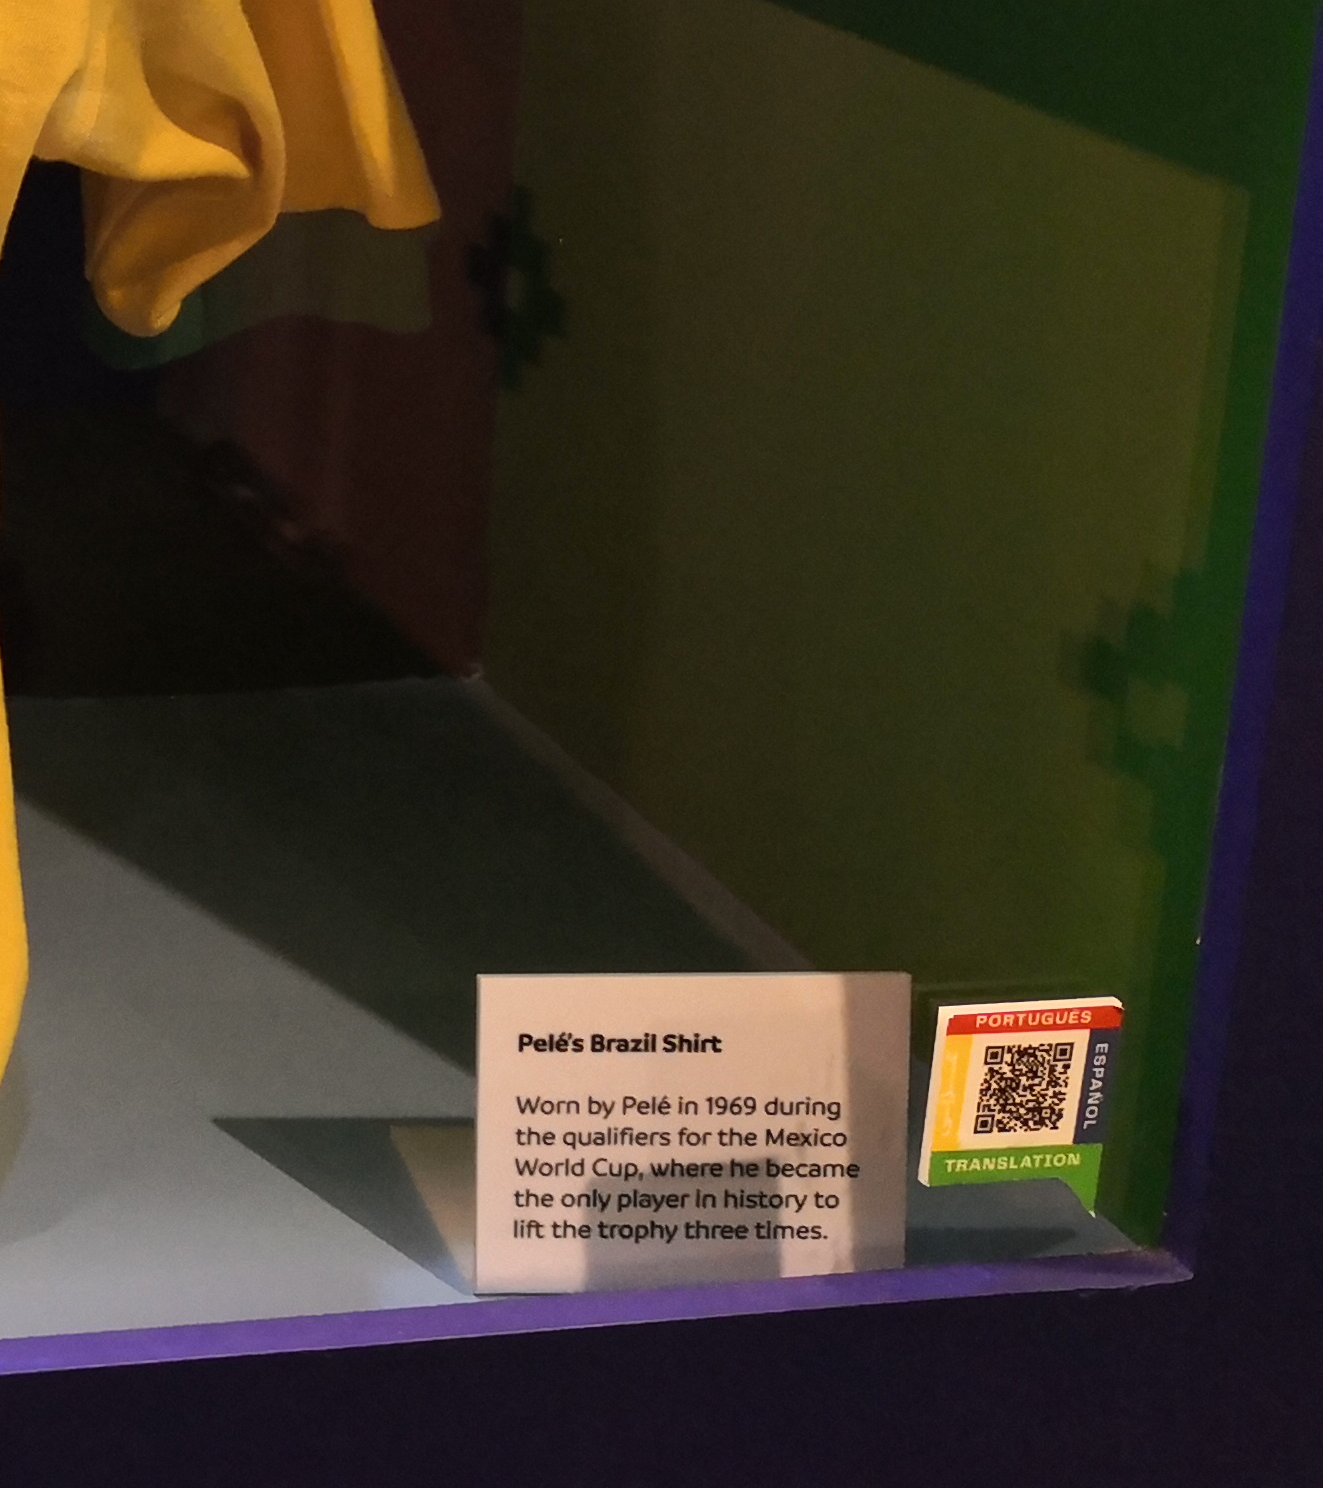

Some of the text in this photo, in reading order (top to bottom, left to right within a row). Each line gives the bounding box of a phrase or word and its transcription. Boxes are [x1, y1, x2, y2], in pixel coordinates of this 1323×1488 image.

[517, 1031, 723, 1053] Pelé's Brazil Shirt
[1082, 1042, 1109, 1130] ESPAÑOL
[516, 1094, 842, 1121] Worn by Pelé in 1969 during
[516, 1126, 848, 1151] the qualifiers for the Mexico
[515, 1157, 861, 1182] World Cup, where he became
[943, 1152, 1082, 1174] TRANSLATION
[514, 1188, 841, 1214] the only player in history to
[512, 1219, 829, 1244] lift the trophy three times.
